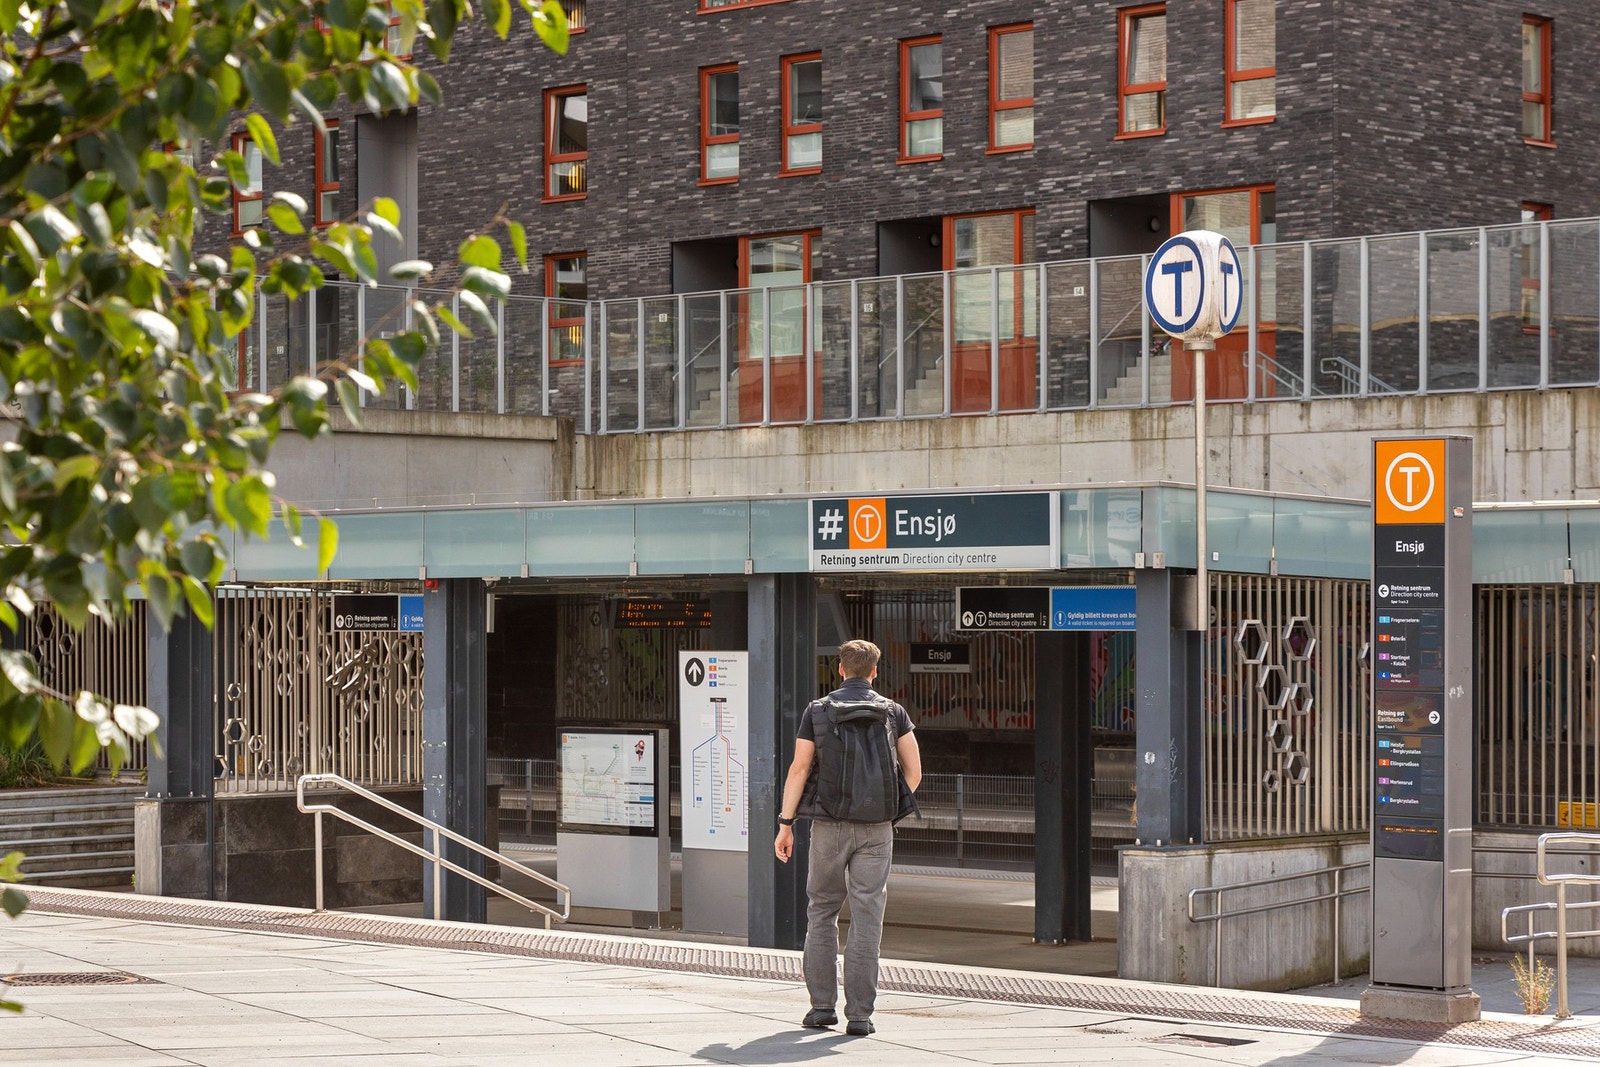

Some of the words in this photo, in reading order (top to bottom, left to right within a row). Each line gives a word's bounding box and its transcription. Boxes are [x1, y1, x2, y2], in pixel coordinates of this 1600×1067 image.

[1162, 260, 1192, 317] T
[1220, 261, 1234, 318] T
[1399, 466, 1420, 503] T
[860, 514, 874, 538] T
[896, 509, 956, 542] Ensjø
[820, 554, 856, 566] Retning
[859, 554, 900, 564] sentrum
[902, 554, 944, 564] Direction
[947, 553, 964, 565] city
[966, 554, 997, 563] centre
[1396, 540, 1424, 554] Ensjø
